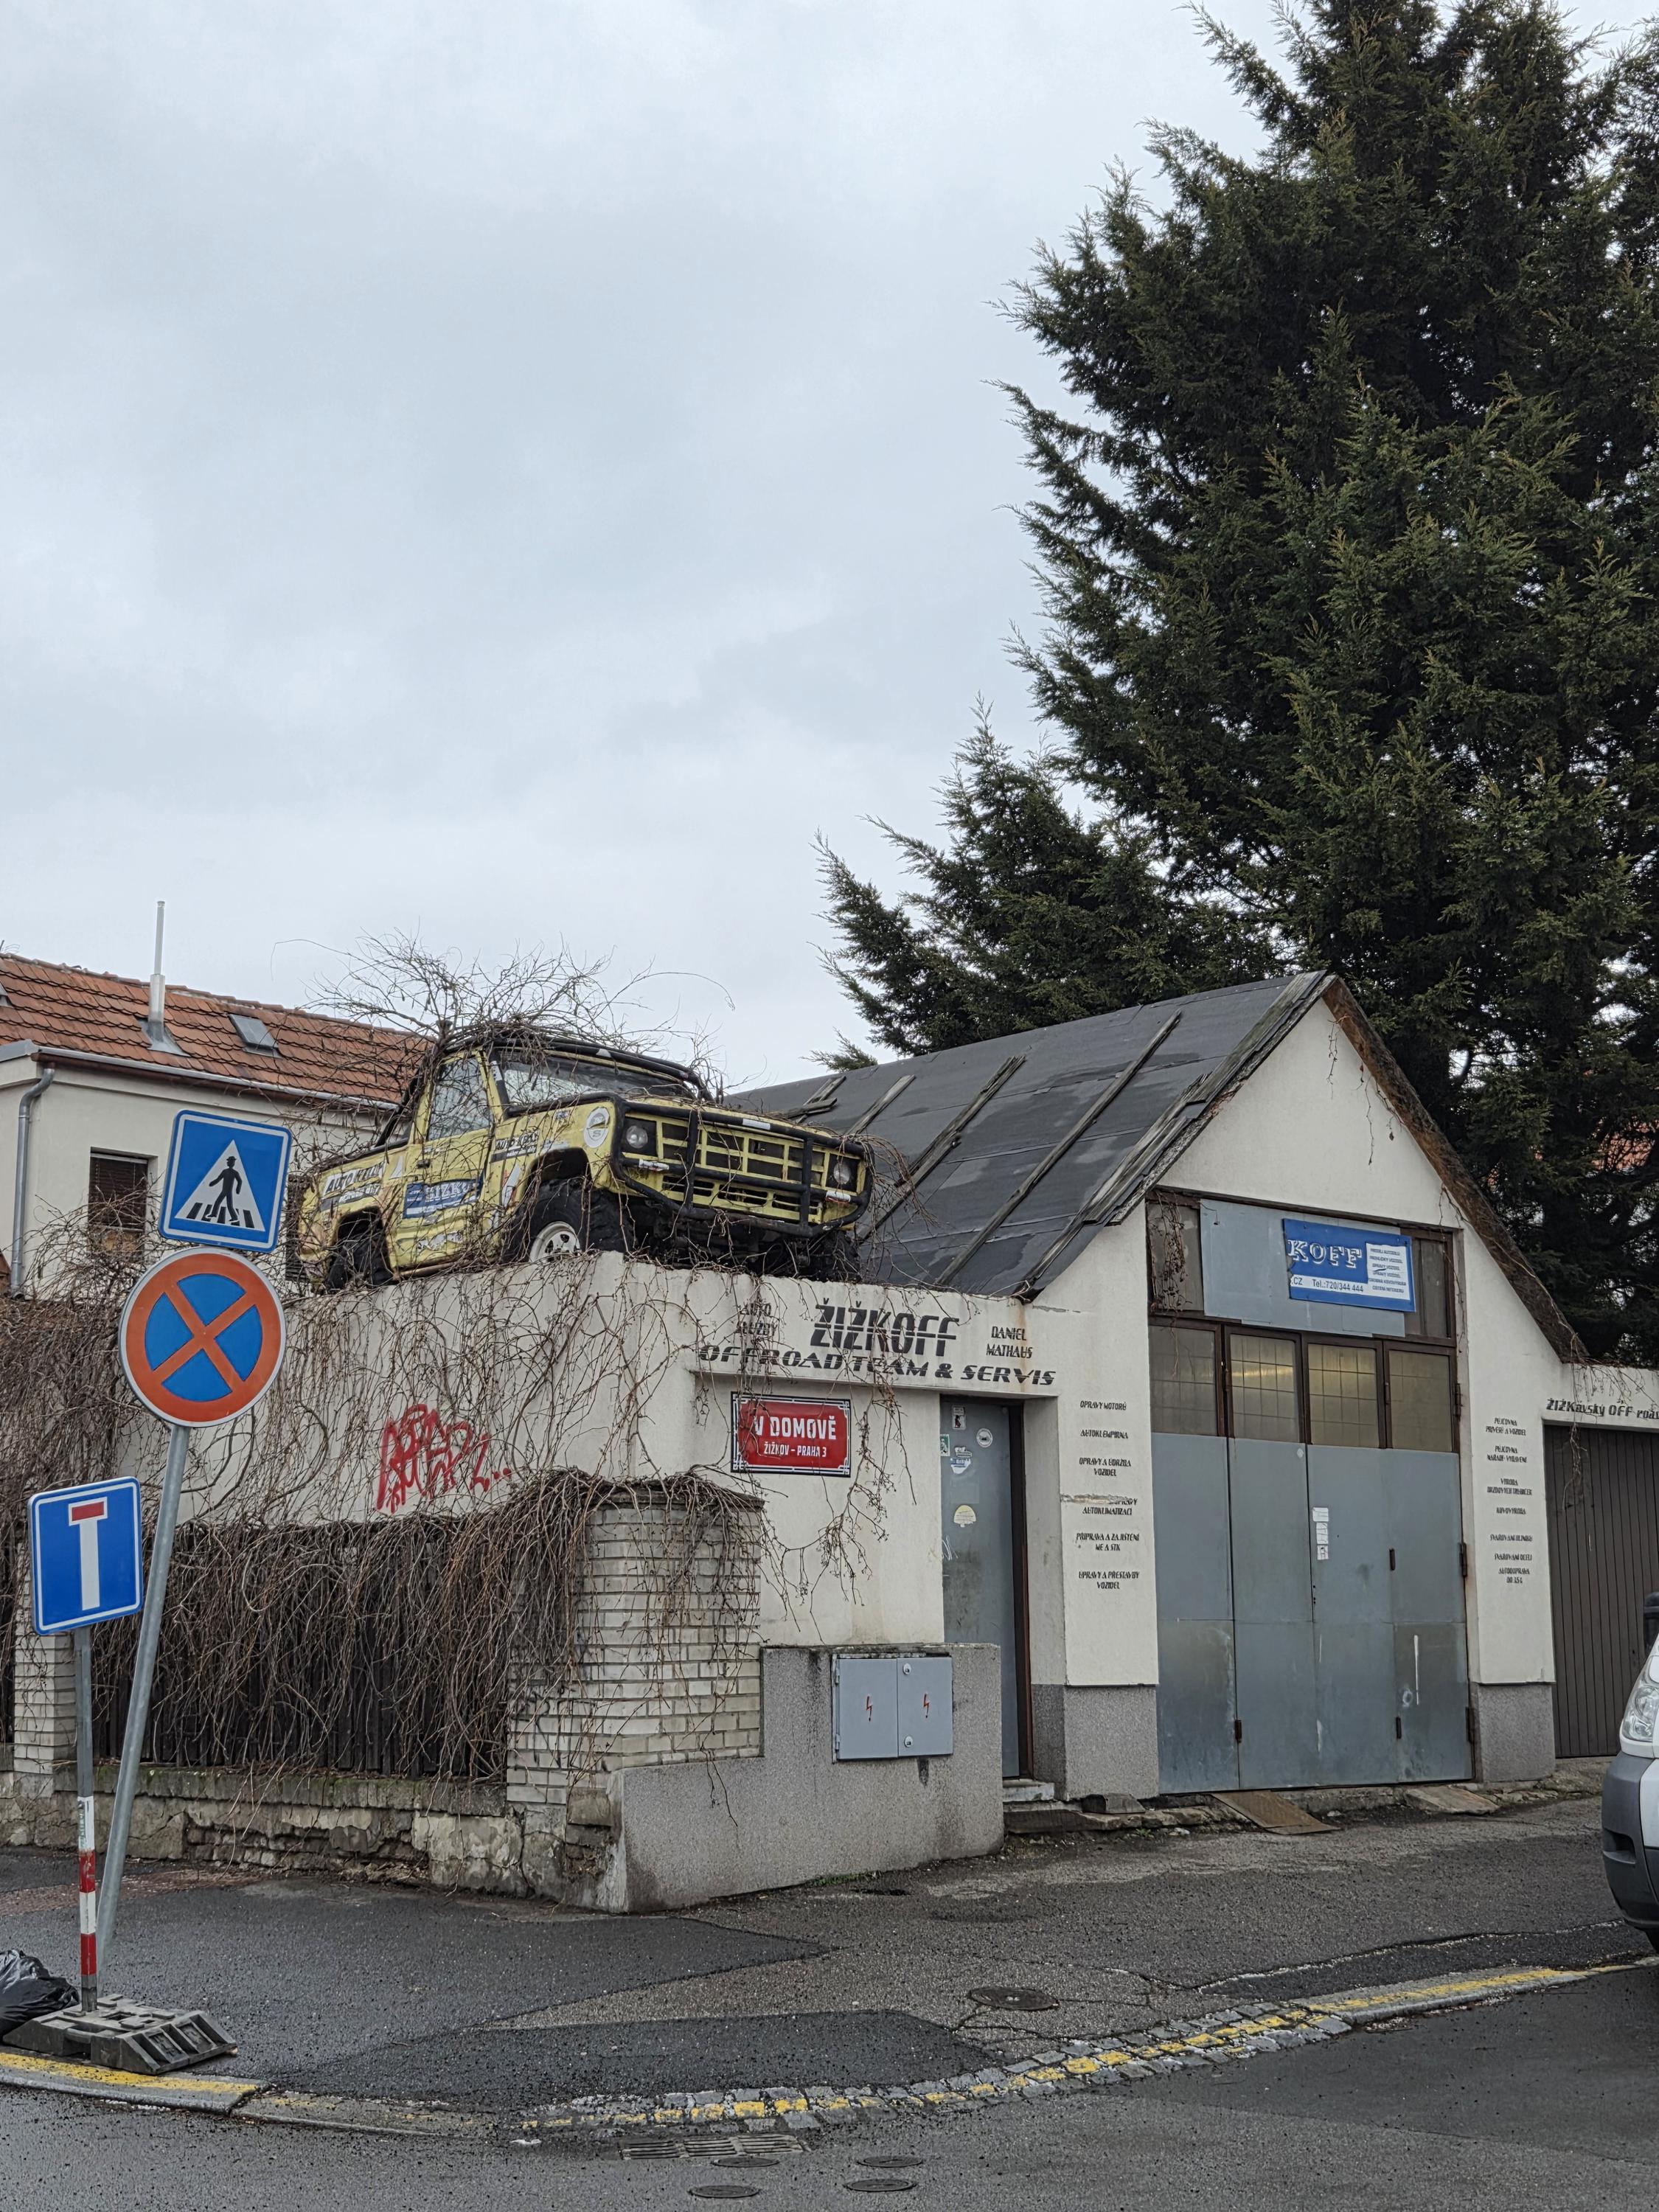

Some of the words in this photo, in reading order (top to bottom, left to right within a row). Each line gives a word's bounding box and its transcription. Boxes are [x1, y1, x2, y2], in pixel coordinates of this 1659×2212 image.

[1287, 1239, 1363, 1269] KOFF
[810, 1298, 959, 1357] ŽIŽKOFF
[992, 1326, 1027, 1341] DANIEL
[986, 1343, 1033, 1359] MATHAUS
[934, 1363, 953, 1379] &
[960, 1364, 1056, 1385] SERVIS
[1079, 1400, 1103, 1410] OPRAVY
[1609, 1405, 1633, 1416] OFF
[754, 1415, 764, 1436] V
[770, 1415, 837, 1441] DOMOVĚ
[763, 1441, 790, 1455] ŽIŽKOV
[797, 1444, 821, 1458] PRAHA
[821, 1446, 827, 1458] 3
[1079, 1457, 1102, 1466] OPRAVY
[1093, 1468, 1117, 1477] VOZIDEL
[1105, 1543, 1110, 1551] A
[1110, 1543, 1121, 1551] STK
[1102, 1571, 1107, 1579] A
[1096, 1581, 1120, 1590] VOZIDEL
